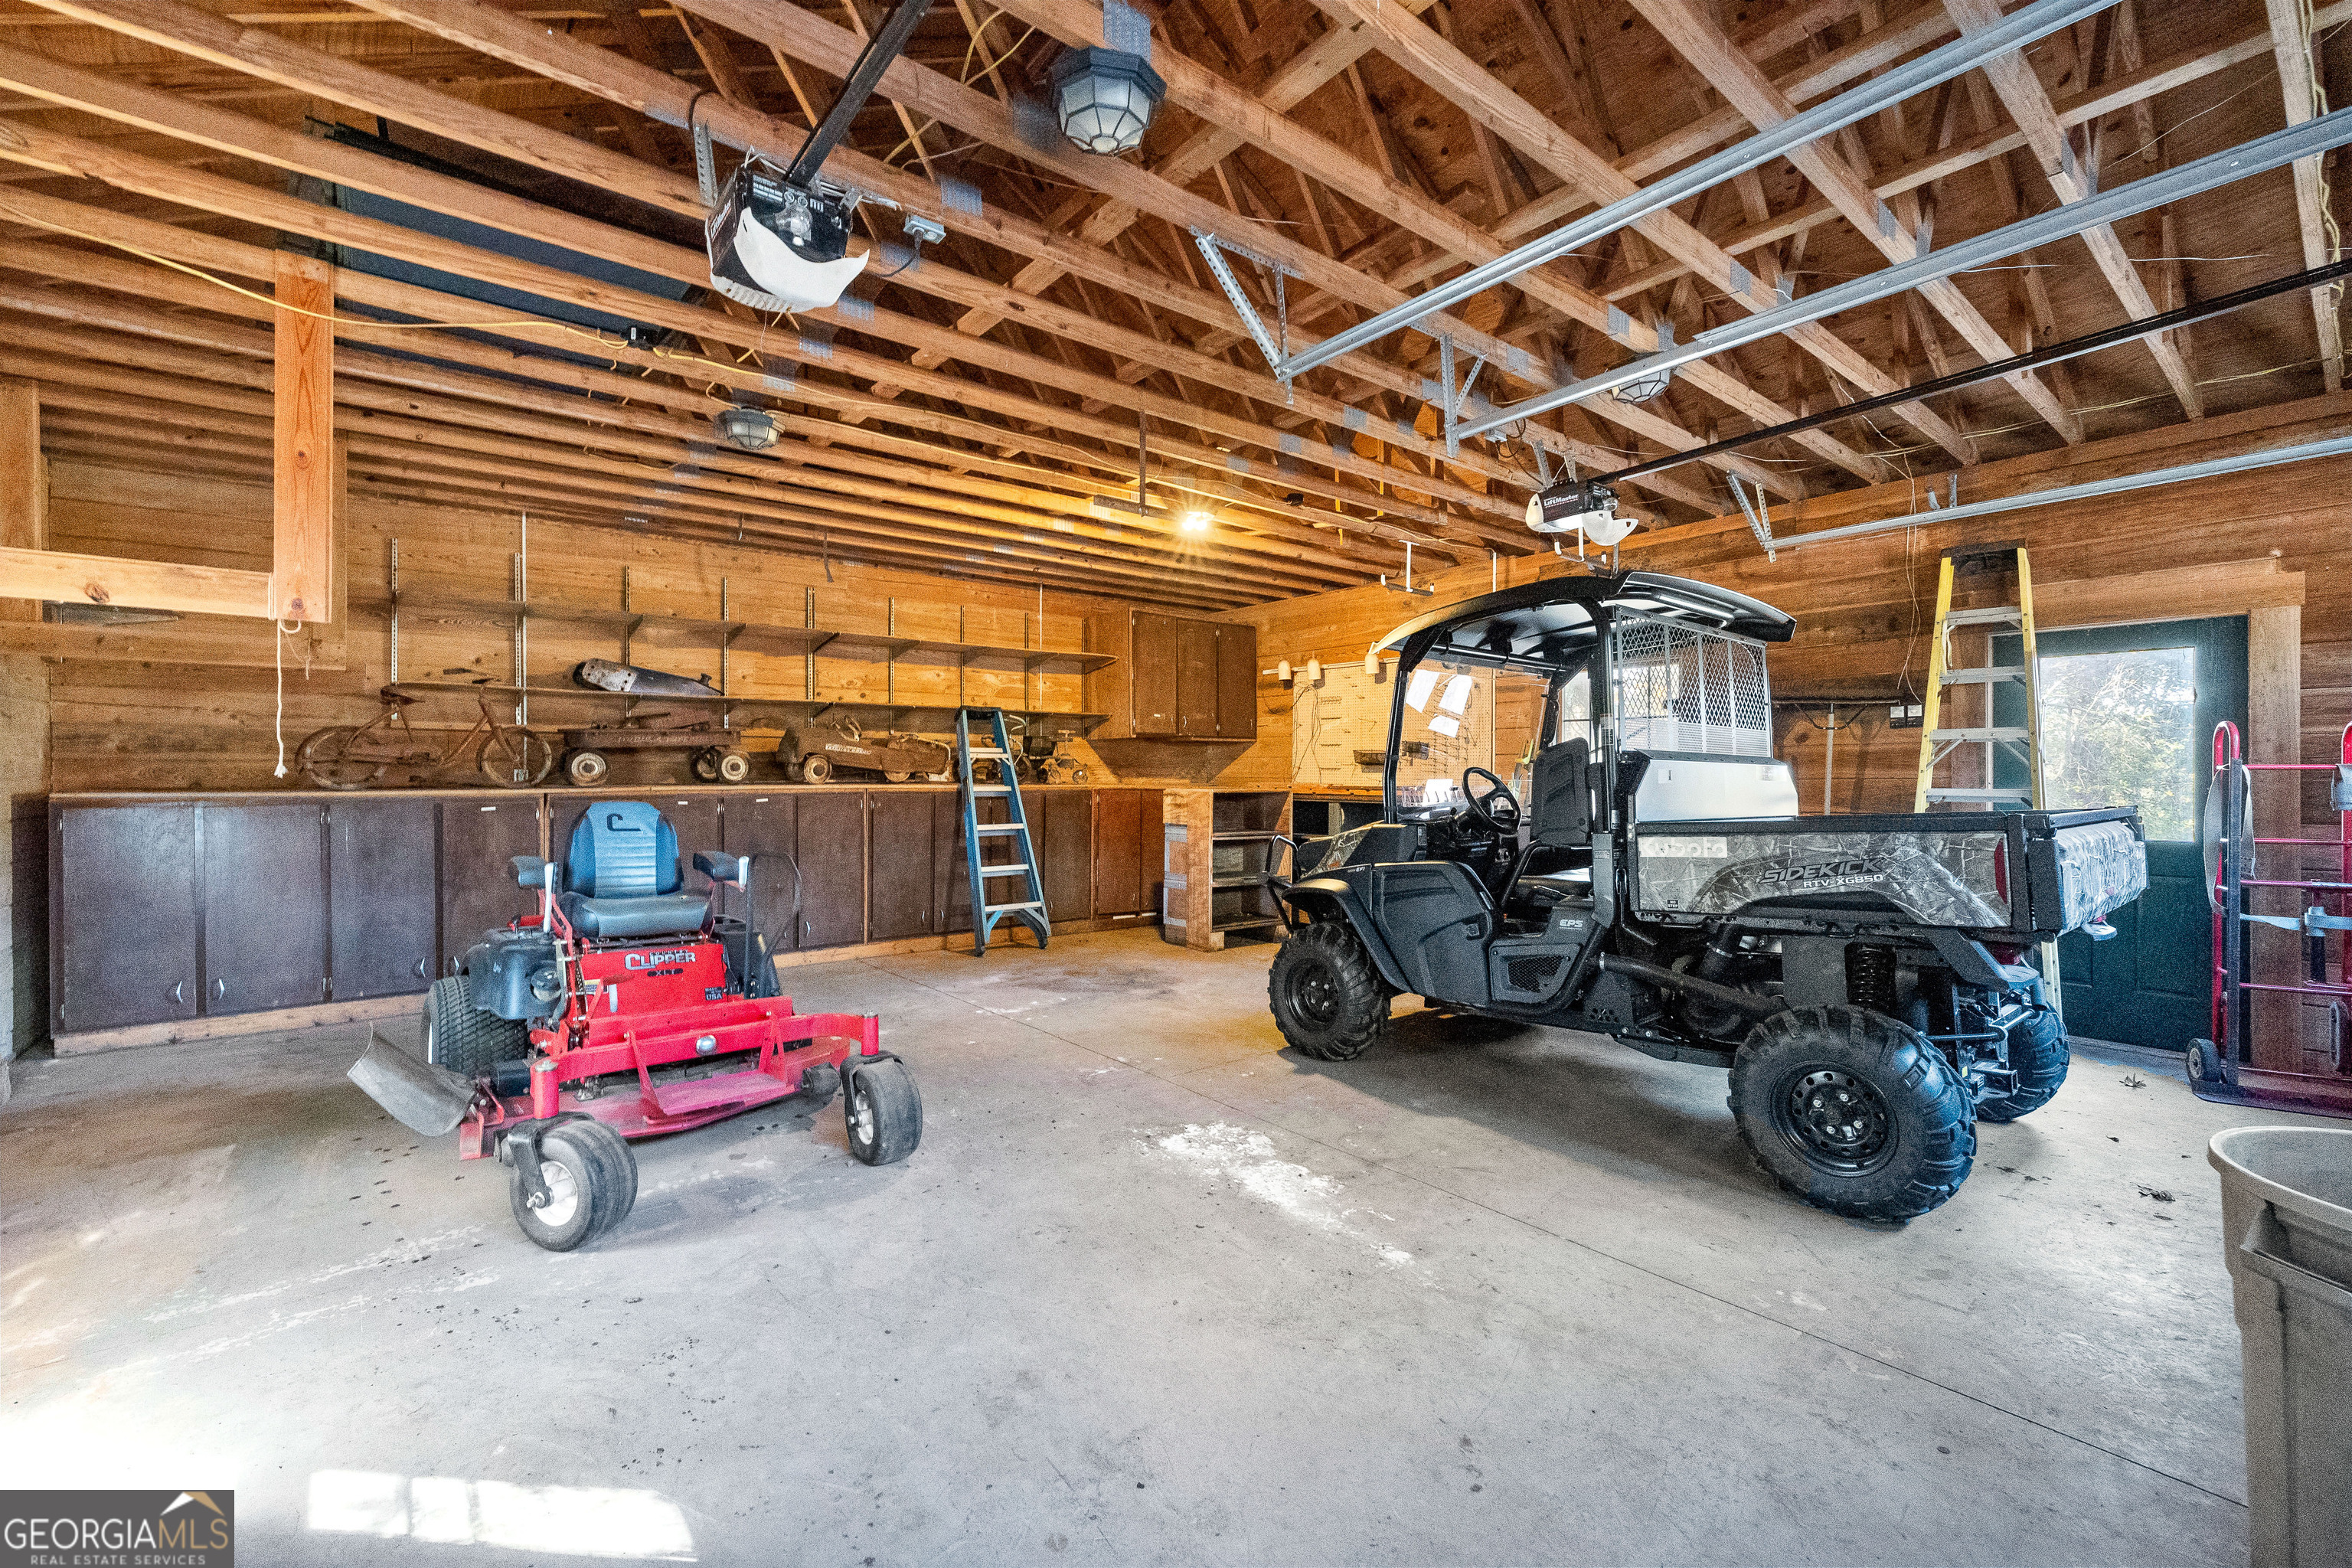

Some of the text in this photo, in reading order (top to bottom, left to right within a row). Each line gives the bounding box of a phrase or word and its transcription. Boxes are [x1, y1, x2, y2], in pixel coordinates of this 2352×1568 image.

[1544, 495, 1579, 506] LiftMaster
[1638, 837, 1726, 858] Kubota
[1762, 858, 1883, 884] SIDEKICK
[1804, 874, 1883, 888] RTV-XG850
[1559, 919, 1583, 927] EPS
[625, 952, 696, 971] CLIPPER
